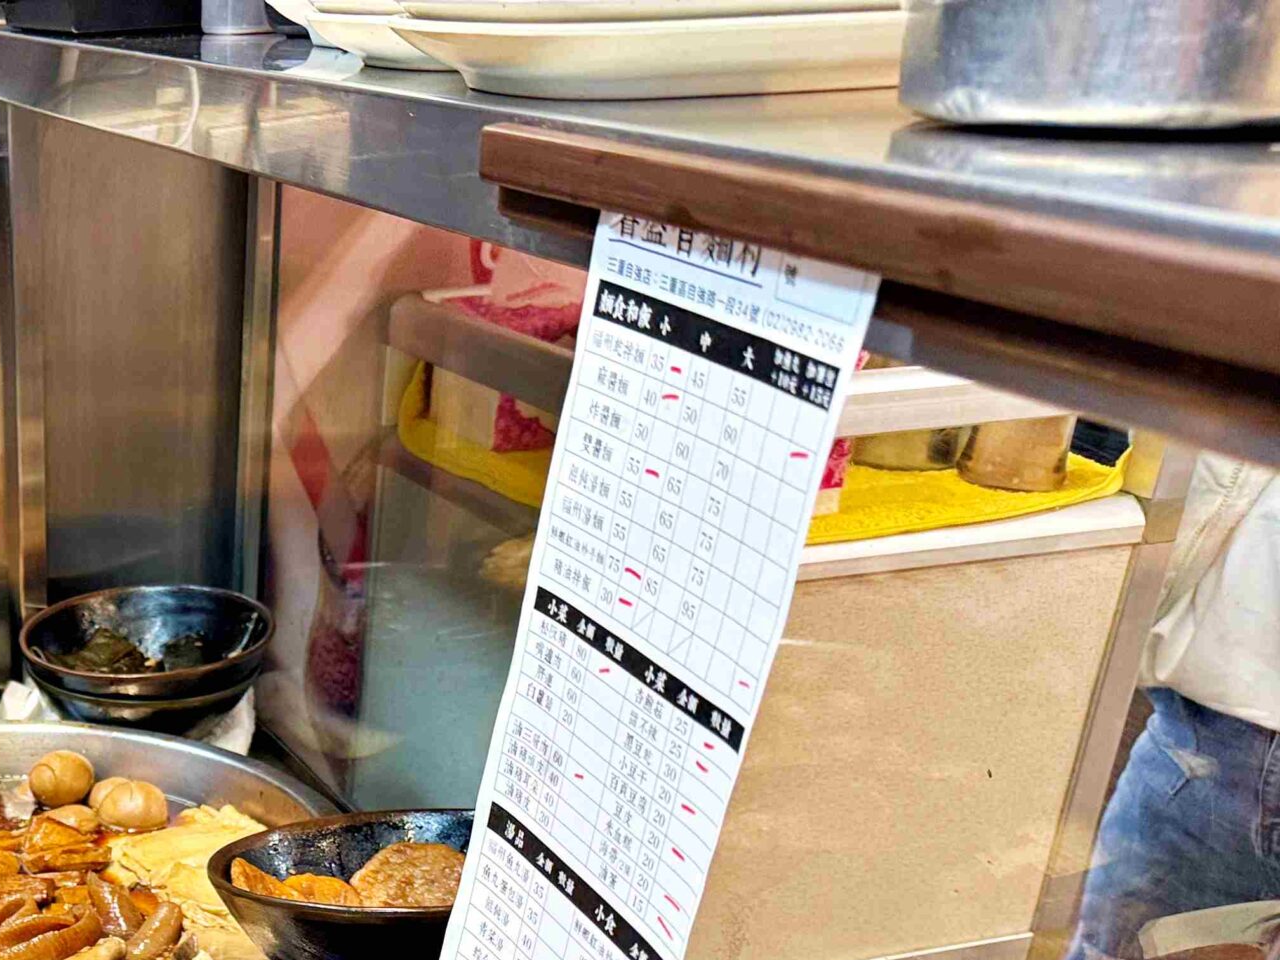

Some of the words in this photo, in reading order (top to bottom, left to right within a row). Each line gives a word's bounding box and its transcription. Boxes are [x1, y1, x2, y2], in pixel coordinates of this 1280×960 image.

[659, 315, 671, 336] 小
[699, 331, 712, 352] 中
[741, 345, 755, 370] 大
[651, 354, 664, 372] 35
[691, 371, 705, 389] 45
[731, 387, 746, 406] 55
[644, 389, 657, 406] 40
[683, 406, 697, 425] 50
[724, 424, 737, 444] 60
[635, 422, 648, 441] 50
[676, 442, 690, 460] 60
[716, 460, 729, 481] 70
[627, 457, 640, 475] 55
[667, 477, 682, 496] 65
[708, 496, 721, 516] 75
[619, 490, 632, 508] 55
[659, 511, 673, 529] 65
[700, 532, 713, 552] 75
[613, 523, 626, 541] 55
[652, 544, 666, 563] 65
[692, 566, 704, 586] 75
[600, 587, 613, 605] 30
[609, 555, 620, 572] 75
[645, 578, 658, 596] 85
[681, 600, 696, 620] 95
[547, 598, 569, 624] 小菜
[576, 645, 587, 661] 80
[571, 667, 581, 683] 60
[644, 665, 668, 694] 小菜
[567, 688, 577, 704] 60
[562, 709, 573, 726] 20
[674, 717, 688, 736] 25
[669, 740, 682, 759] 25
[553, 751, 563, 767] 60
[549, 772, 559, 786] 40
[664, 764, 677, 782] 30
[544, 792, 554, 807] 40
[658, 786, 671, 804] 20
[539, 811, 549, 827] 30
[653, 809, 666, 827] 20
[647, 831, 660, 849] 20
[642, 853, 654, 871] 20
[533, 882, 544, 899] 35
[637, 874, 649, 892] 20
[632, 896, 643, 912] 15
[527, 907, 538, 925] 35
[522, 934, 532, 950] 40
